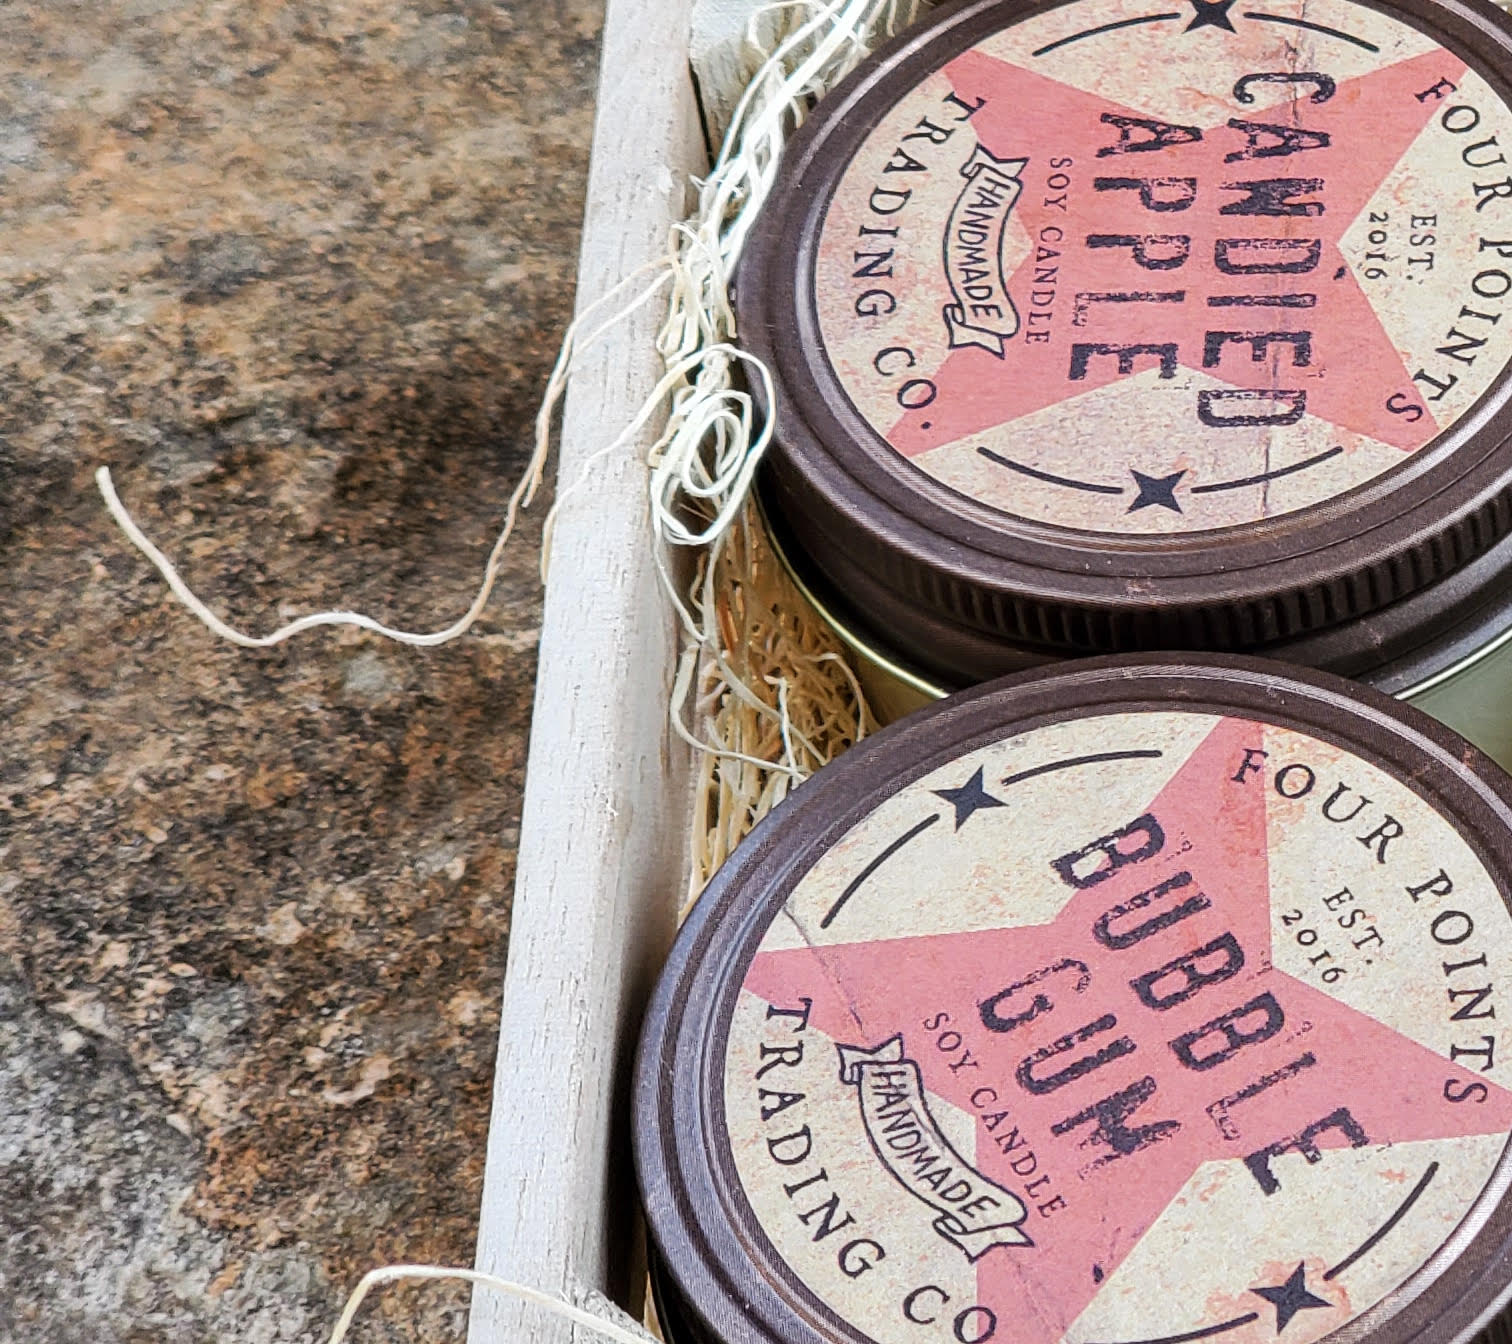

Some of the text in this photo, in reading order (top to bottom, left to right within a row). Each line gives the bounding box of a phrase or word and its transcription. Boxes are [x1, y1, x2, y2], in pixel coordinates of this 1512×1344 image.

[853, 89, 988, 430] TRADING CO.
[956, 175, 1006, 320] HANDMADE
[1025, 156, 1073, 345] SOY CANDLE
[1068, 112, 1204, 380] APPLE
[1197, 71, 1336, 428] CANDIED
[1364, 211, 1388, 279] 2016
[1408, 213, 1438, 282] EST.
[1050, 814, 1369, 1195] BUBBLE
[1229, 747, 1498, 1107] FOUR POINTS
[1281, 909, 1345, 984] 2016
[1322, 887, 1385, 963] EST.
[755, 997, 885, 1279] TRADING
[870, 1072, 1002, 1222] HANDMADE
[922, 1011, 1067, 1220] SOY CANDLE
[979, 958, 1179, 1160] GUM
